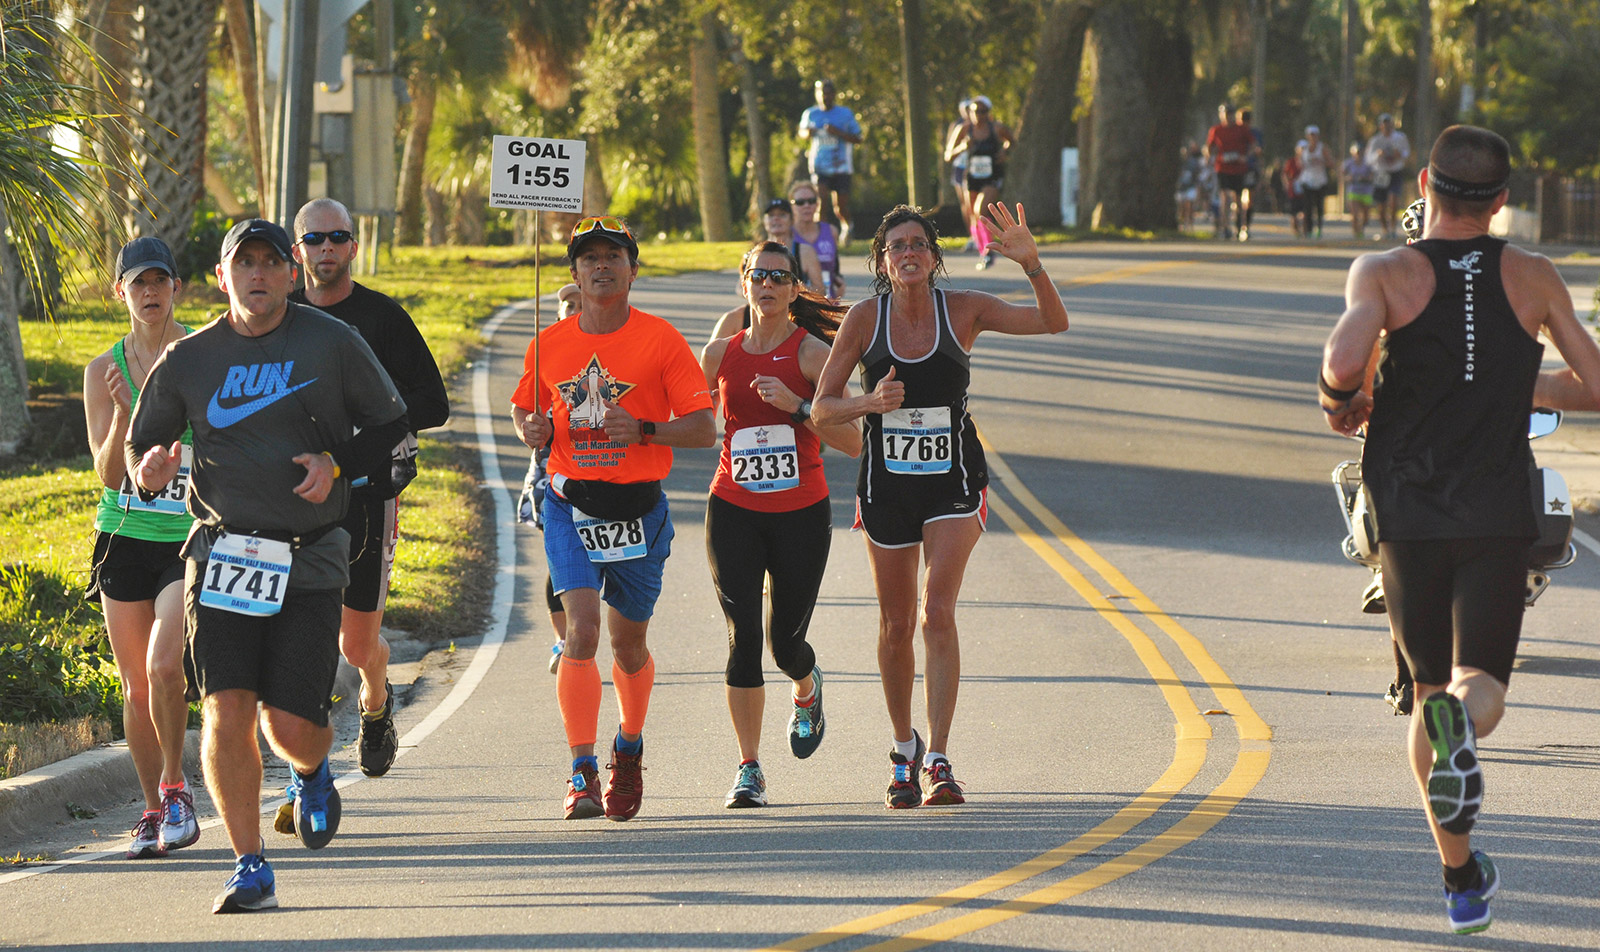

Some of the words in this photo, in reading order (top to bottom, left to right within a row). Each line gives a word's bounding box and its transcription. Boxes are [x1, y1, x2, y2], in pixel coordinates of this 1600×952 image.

[508, 141, 570, 159] GOAL
[507, 164, 569, 188] 1:55
[495, 199, 577, 210] JIM@MARATHONPACING.COM
[220, 360, 294, 399] RUN
[886, 435, 948, 461] 1768
[733, 453, 796, 482] 2333
[122, 472, 187, 500] 15
[579, 520, 642, 550] 3628
[210, 552, 227, 562] SPACE
[228, 556, 245, 565] COAST
[246, 558, 259, 568] HALF
[260, 562, 289, 573] MARATHON
[207, 562, 280, 602] 1741
[231, 600, 250, 609] DAVID
